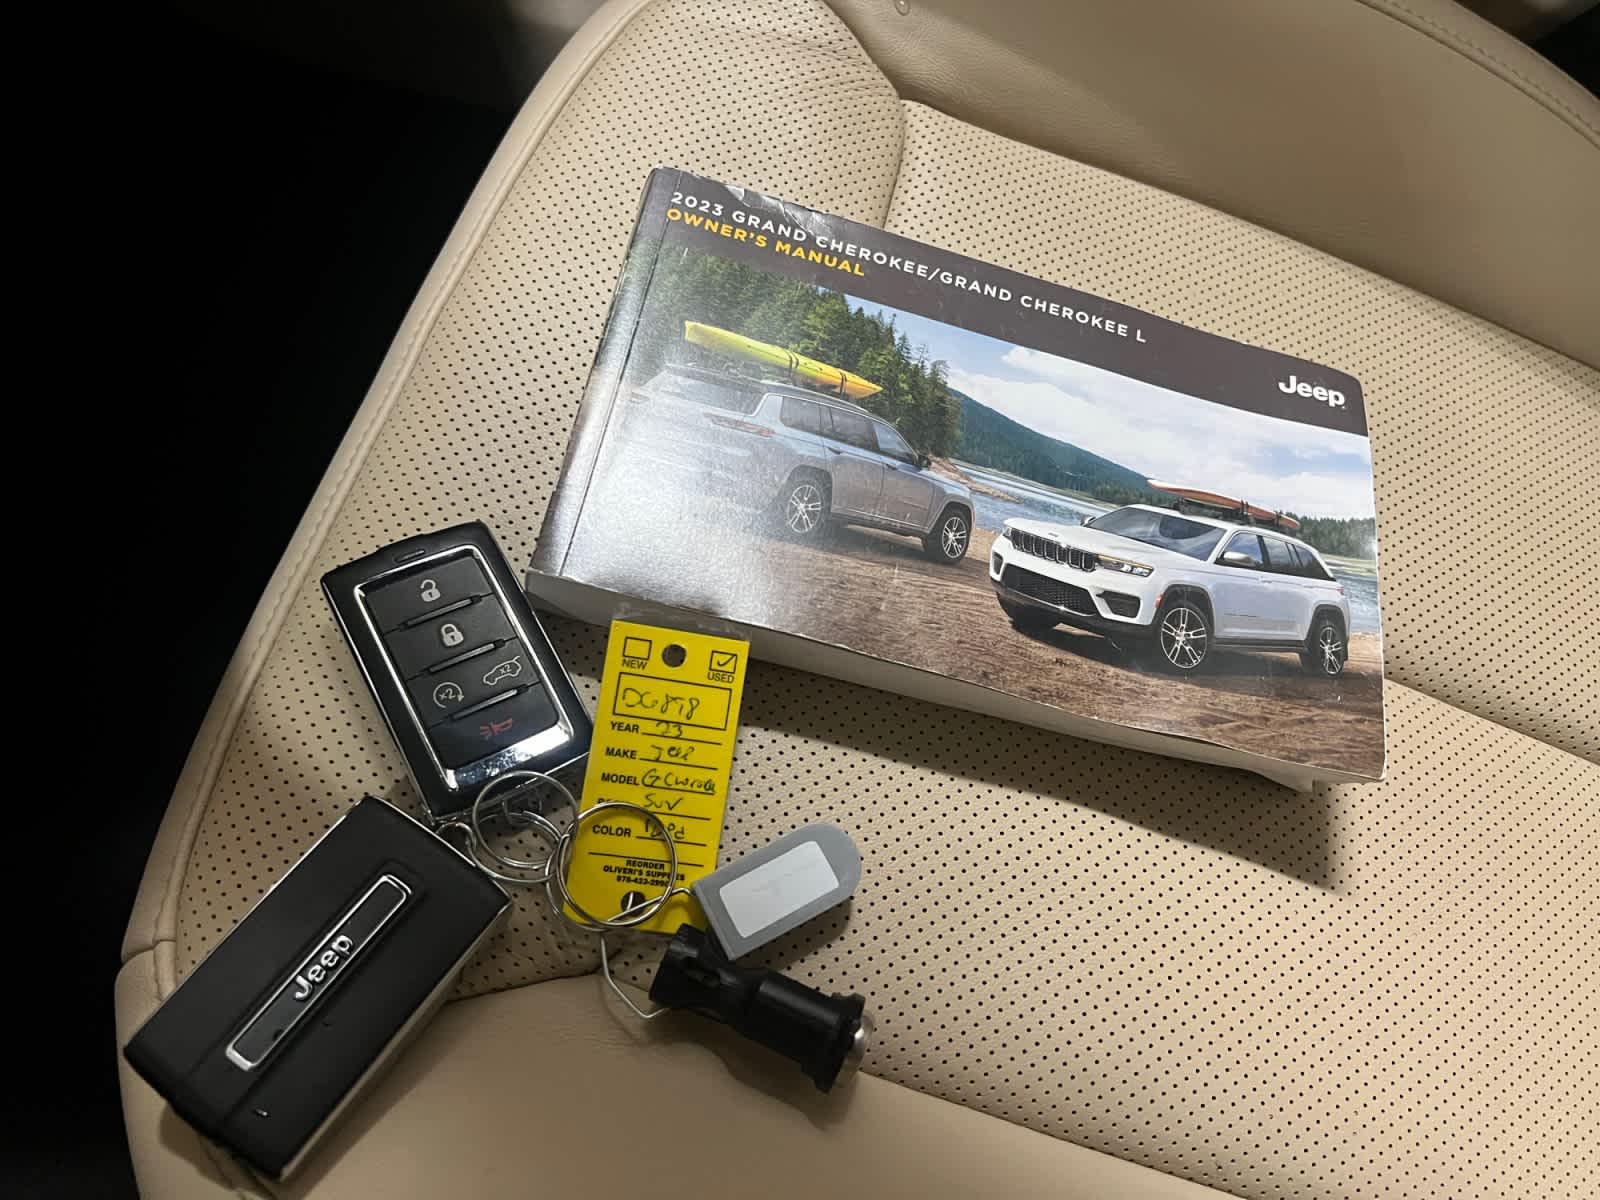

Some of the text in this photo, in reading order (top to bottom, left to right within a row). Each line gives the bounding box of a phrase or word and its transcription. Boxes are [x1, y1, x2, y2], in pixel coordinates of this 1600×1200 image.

[666, 208, 866, 276] OWNER'S MANUAL
[671, 192, 1147, 343] 2023 GRAND CHEROKEE/GRAND CHEROKEE L
[1278, 375, 1345, 407] Jeep
[622, 659, 648, 670] NEW
[707, 672, 735, 684] USED
[610, 721, 640, 734] YEAR
[605, 747, 637, 759] MAKE
[601, 773, 639, 786] MODEL
[592, 824, 631, 837] COLOR
[626, 860, 665, 870] REORDER
[295, 935, 353, 998] Jeep
